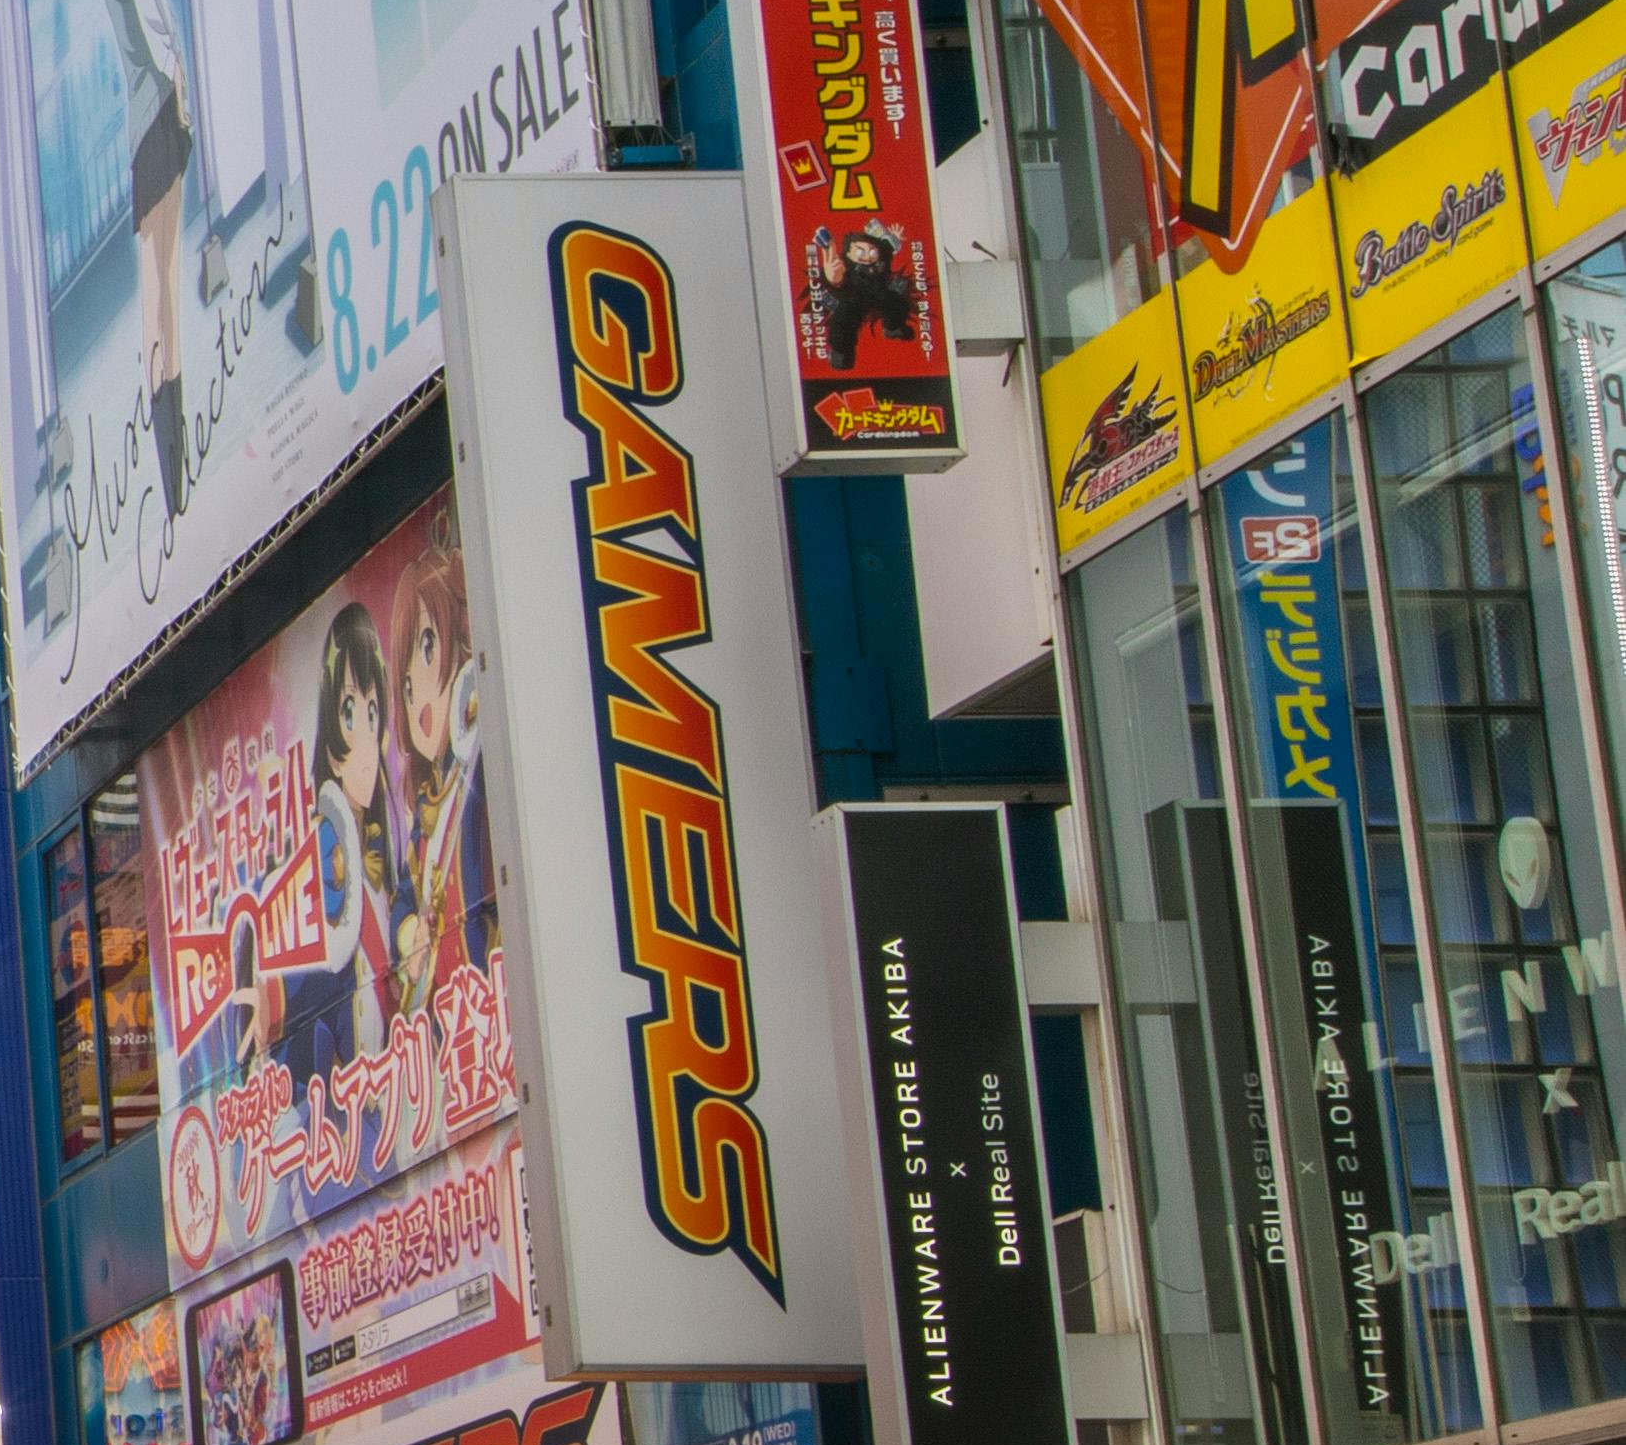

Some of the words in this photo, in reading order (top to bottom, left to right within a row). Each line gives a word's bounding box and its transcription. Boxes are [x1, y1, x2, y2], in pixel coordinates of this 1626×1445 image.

[327, 143, 440, 397] 8.22
[436, 86, 485, 177] ON
[1351, 222, 1431, 300] Battle
[1430, 169, 1507, 253] Spirits
[835, 406, 943, 437] カードキングダム
[548, 221, 789, 1311] GAMERS
[258, 866, 320, 960] LIVE
[881, 937, 914, 1045] AKIBA
[894, 1060, 928, 1175] STORE
[981, 1072, 1003, 1127] Site
[992, 1135, 1018, 1202] Real
[298, 1164, 502, 1329] 事前登録受付中!
[999, 1208, 1024, 1267] Dell
[1367, 1210, 1460, 1286] Dell
[908, 1190, 954, 1407] ALIENWARE
[763, 1420, 797, 1445] (WED)
